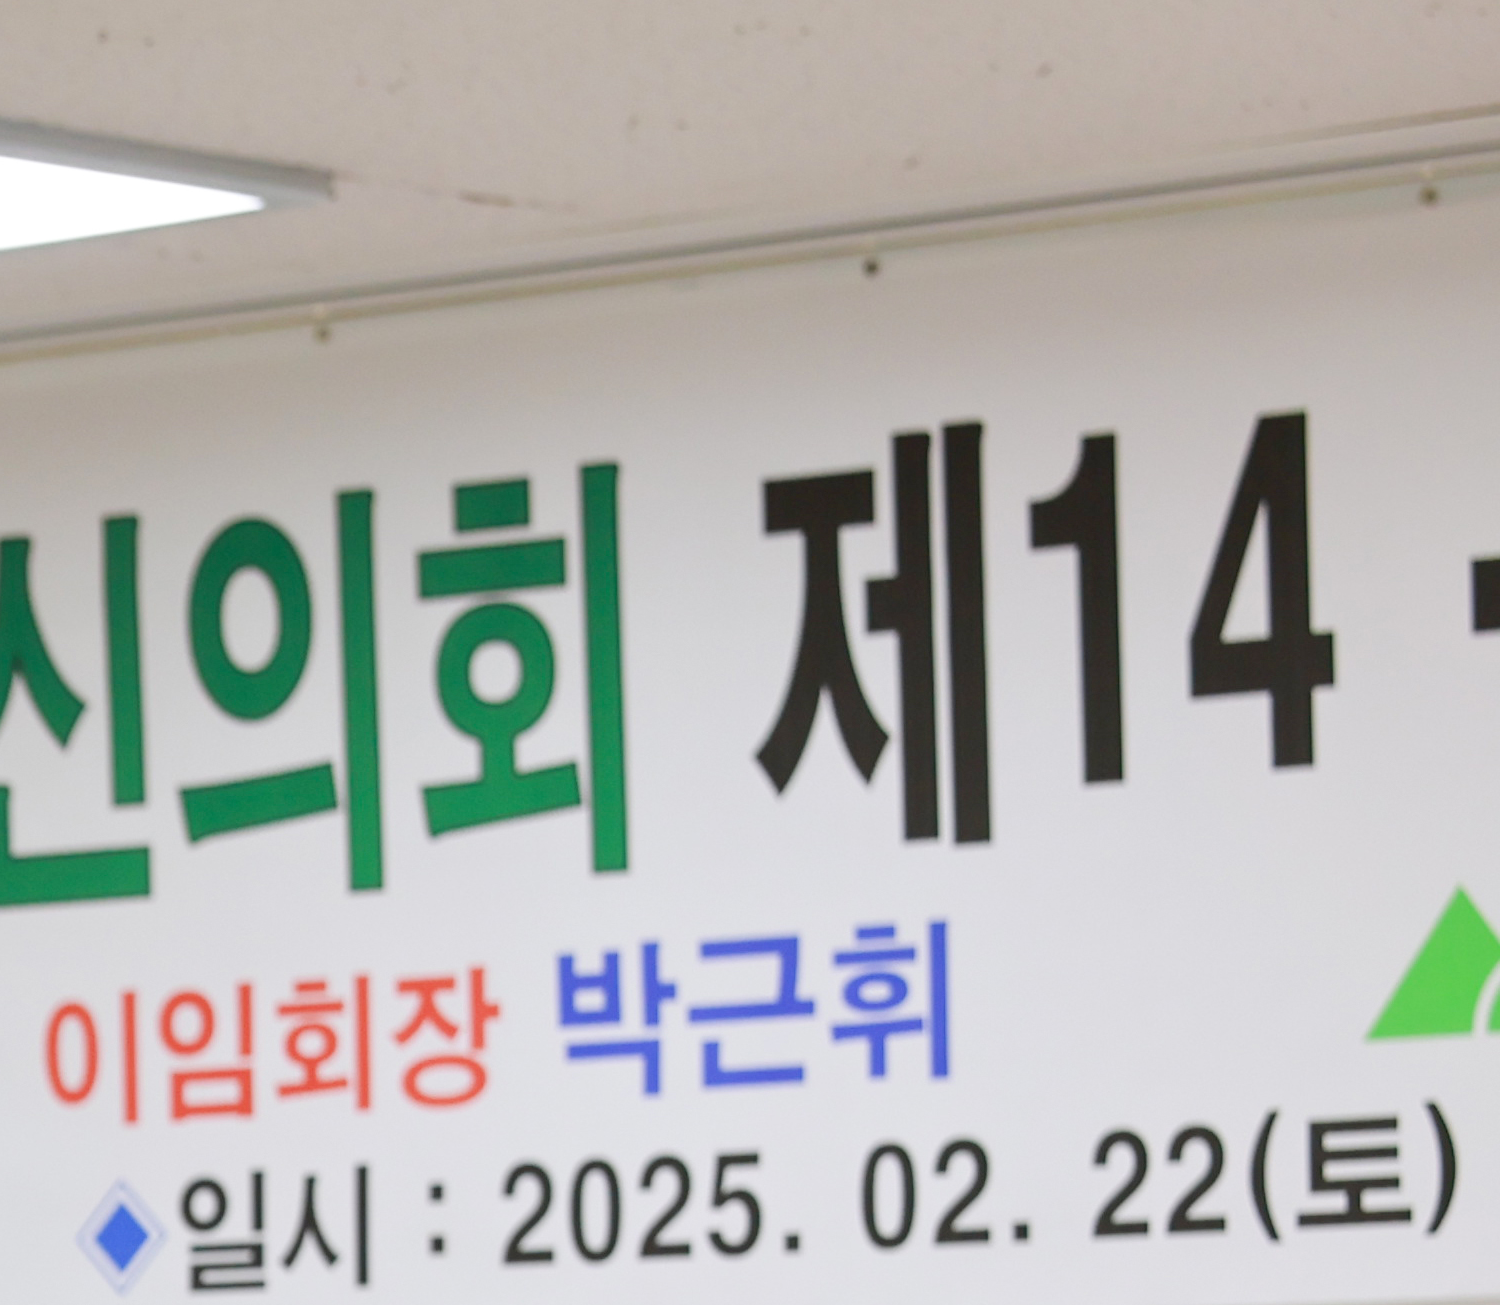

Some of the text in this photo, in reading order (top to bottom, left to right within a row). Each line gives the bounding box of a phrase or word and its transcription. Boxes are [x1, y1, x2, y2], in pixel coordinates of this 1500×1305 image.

[755, 410, 1336, 845] 제14
[43, 918, 956, 1126] 이임회장 박근휘
[180, 1164, 372, 1293] 일시
[502, 1150, 803, 1265] 2025.
[861, 1138, 1032, 1250] 02.
[1092, 1101, 1458, 1243] 22(토)
